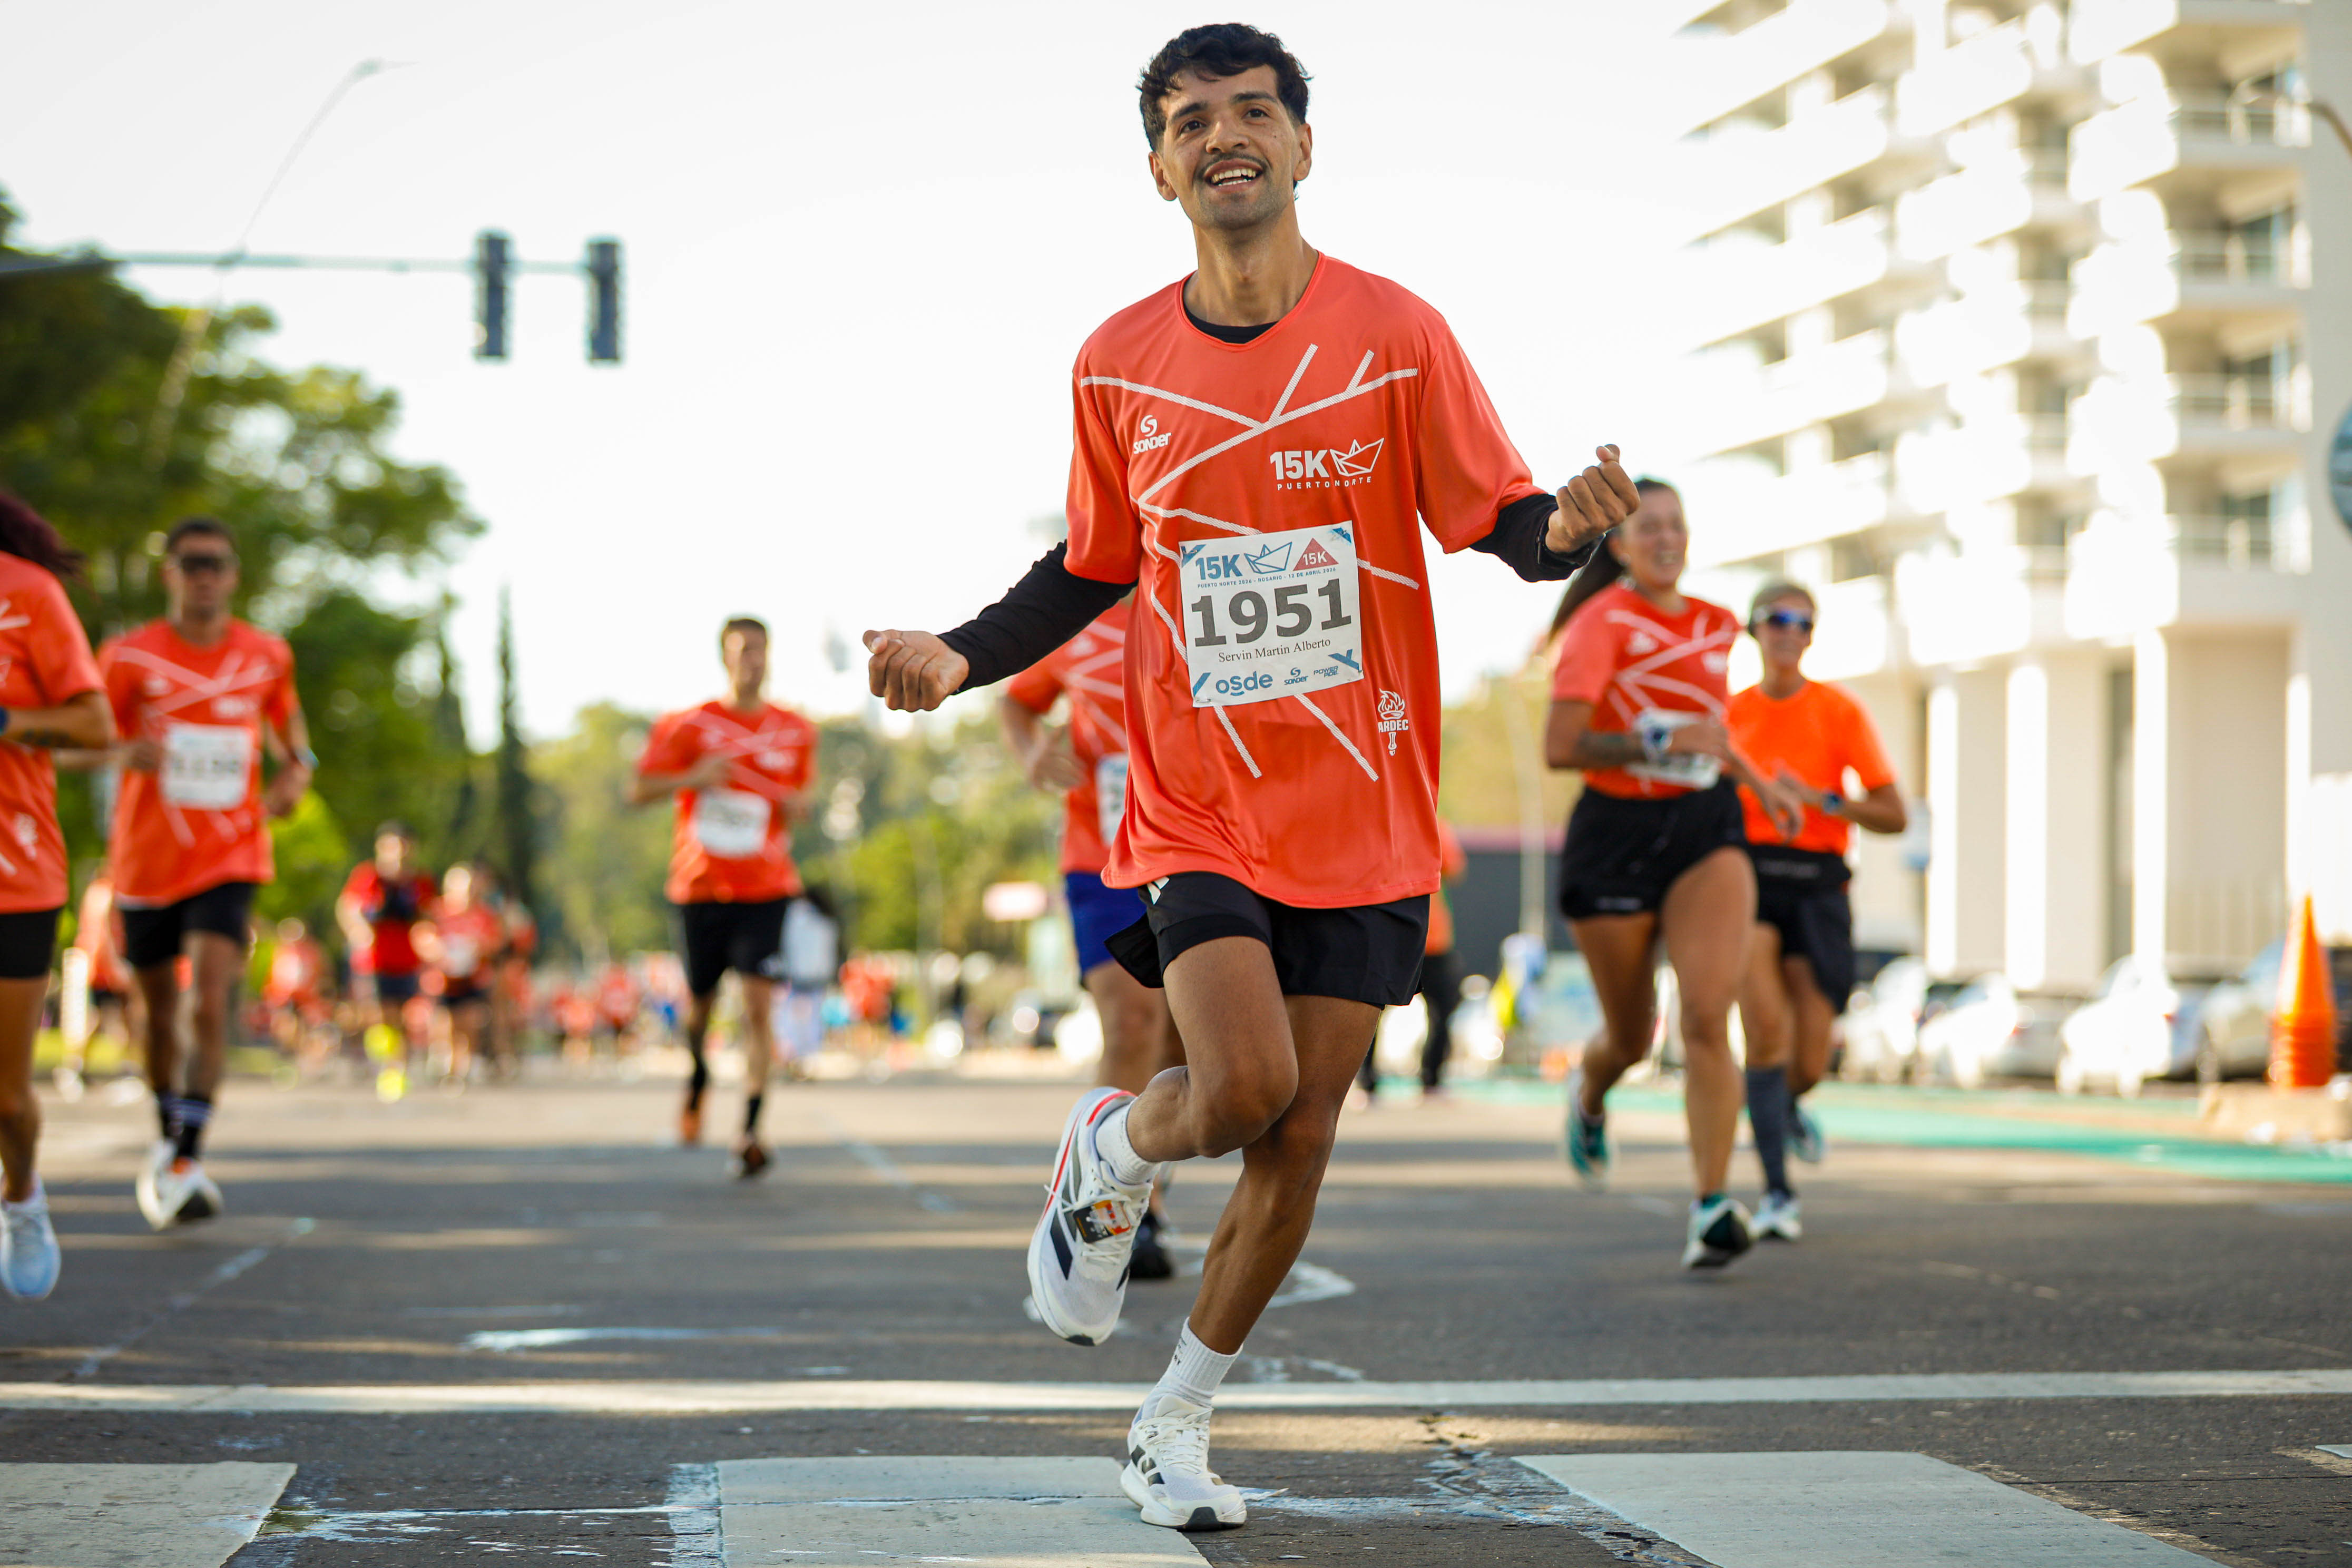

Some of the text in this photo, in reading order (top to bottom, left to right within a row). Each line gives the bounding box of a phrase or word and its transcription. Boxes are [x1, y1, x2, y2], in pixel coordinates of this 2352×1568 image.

[1270, 449, 1330, 480] 15K
[1195, 554, 1243, 580] 15K
[1303, 551, 1328, 565] 15K
[1191, 578, 1352, 647] 1951
[1218, 639, 1331, 662] Servin Martin Alberto
[1314, 665, 1339, 675] POWER
[1216, 670, 1273, 694] osde
[1377, 719, 1409, 733] ARDEC
